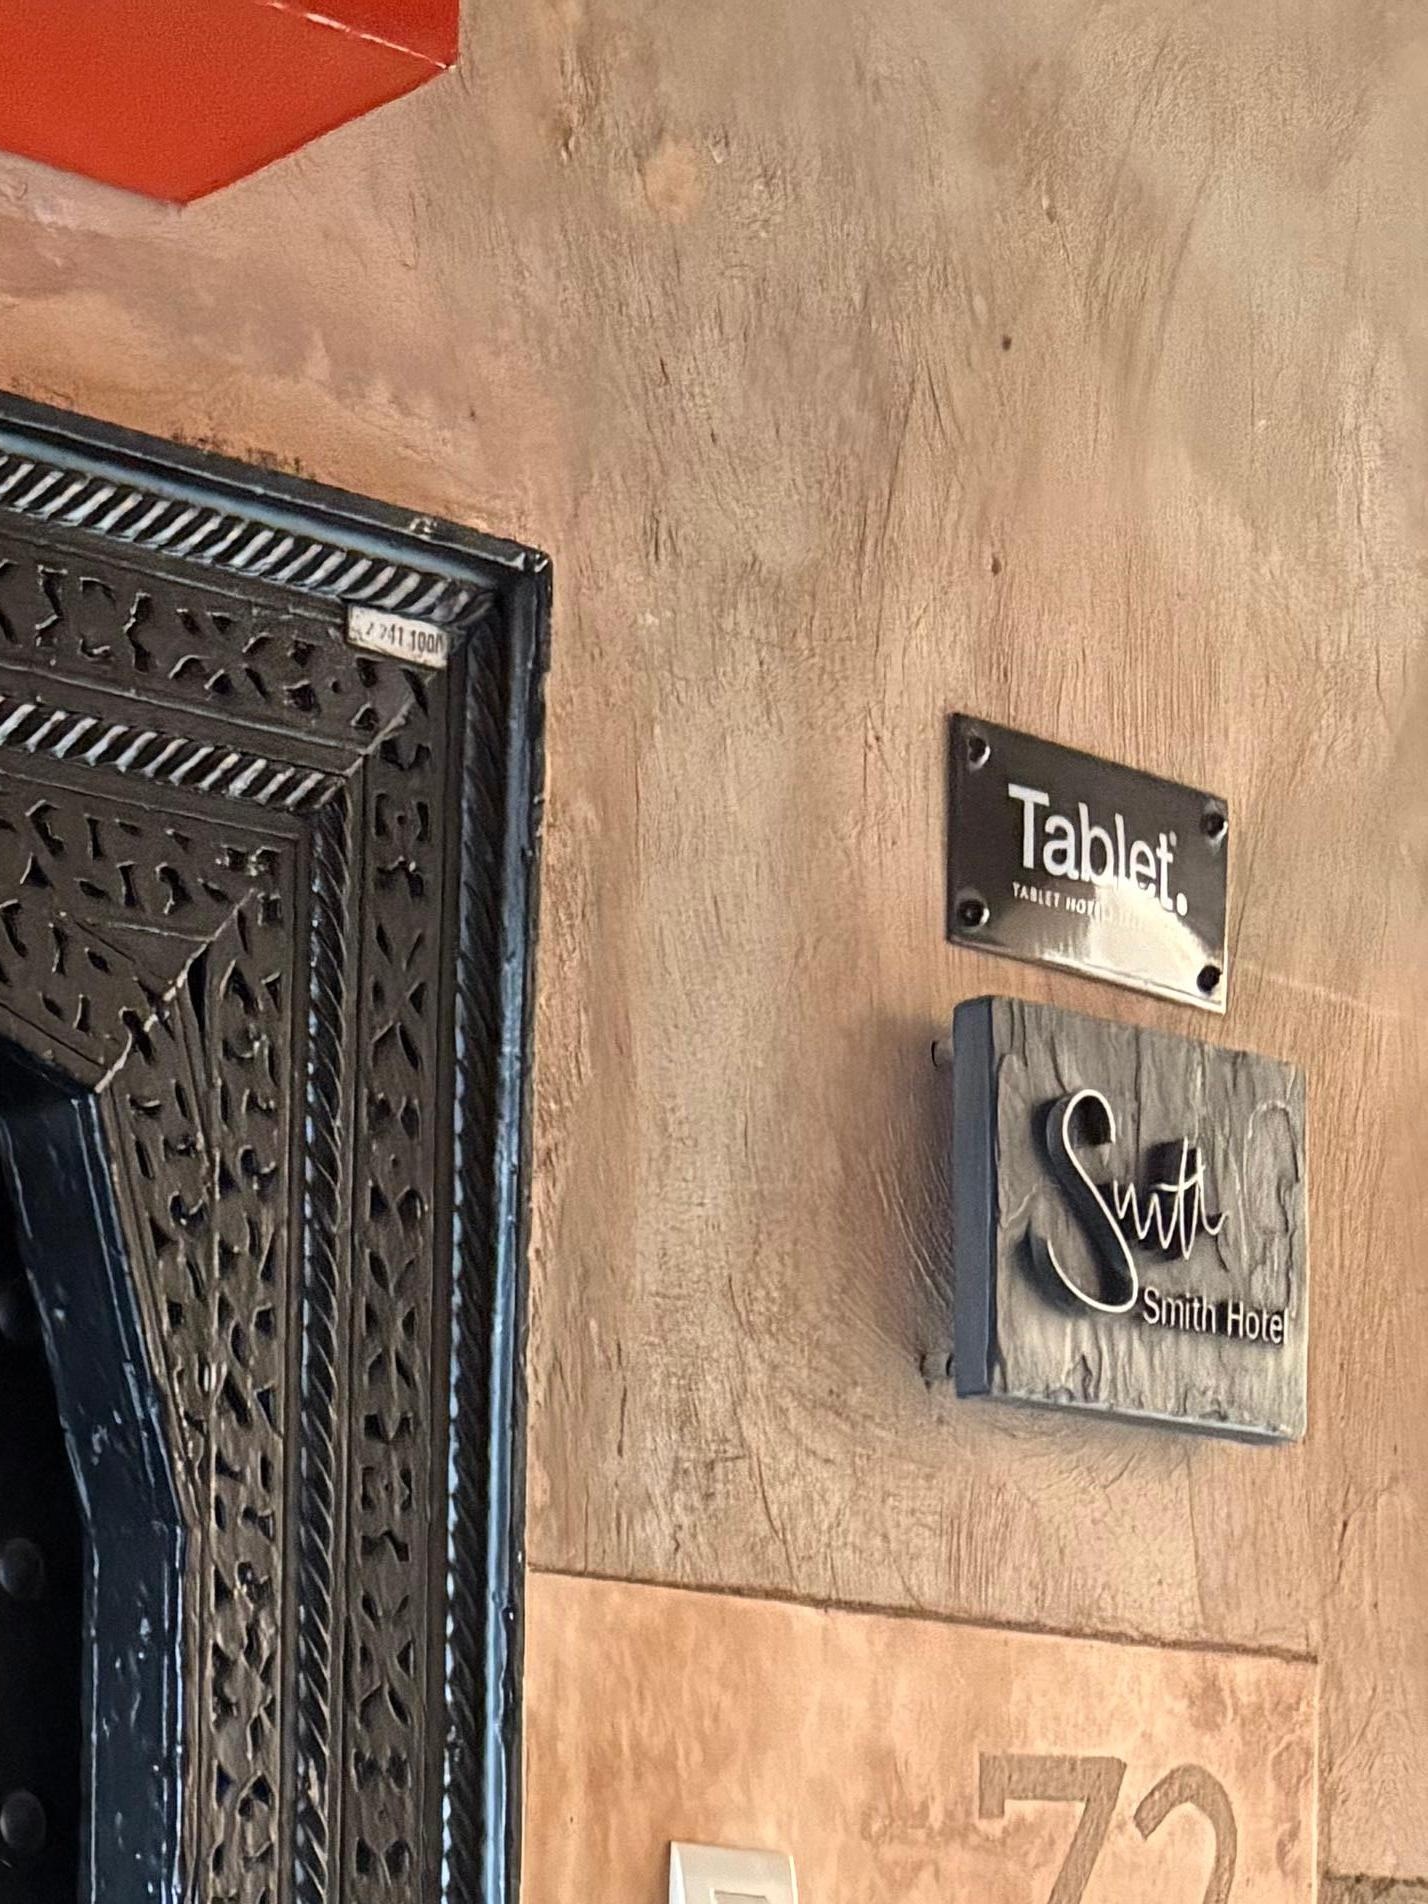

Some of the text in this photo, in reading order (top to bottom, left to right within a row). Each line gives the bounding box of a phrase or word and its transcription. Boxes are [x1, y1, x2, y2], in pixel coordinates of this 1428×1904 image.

[1012, 881, 1060, 908] TABLET
[1143, 1286, 1289, 1345] Smith Hotel
